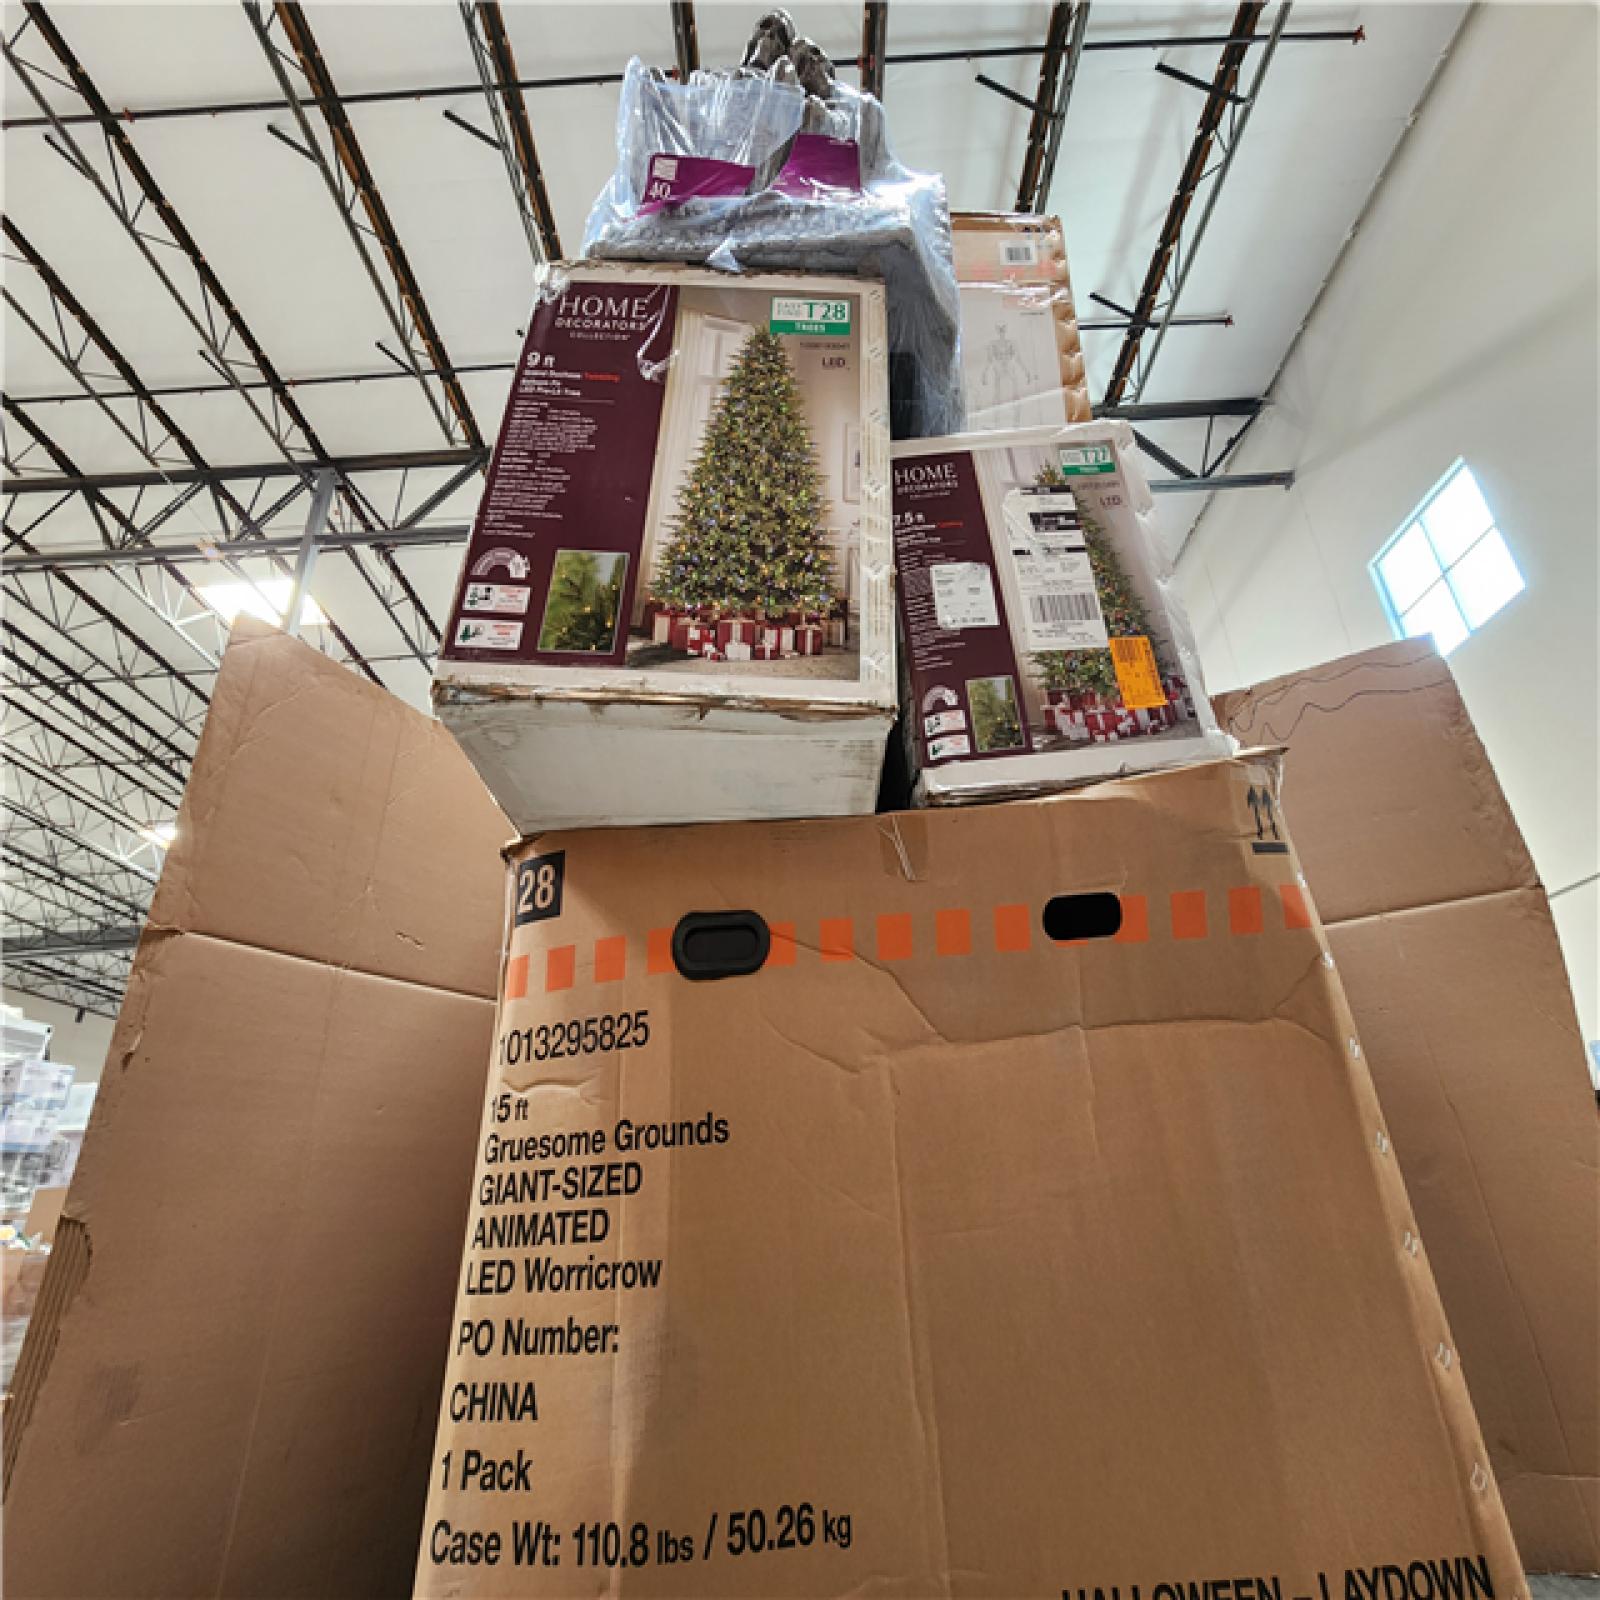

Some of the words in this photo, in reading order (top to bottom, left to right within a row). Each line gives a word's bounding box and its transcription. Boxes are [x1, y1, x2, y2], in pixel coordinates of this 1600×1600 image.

[559, 294, 648, 319] HOME
[894, 463, 959, 485] HOME
[518, 864, 556, 914] 28
[515, 1098, 529, 1120] ft
[485, 1129, 605, 1164] Gruesome
[614, 1112, 729, 1151] Grounds
[479, 1162, 642, 1206] GIANT-SIZED
[472, 1208, 610, 1249] ANIMATED
[465, 1259, 515, 1295] LED
[524, 1254, 662, 1293] Worricrow
[457, 1319, 495, 1356] PO
[502, 1315, 619, 1356] Number:
[450, 1381, 538, 1422] CHINA
[442, 1451, 452, 1490] 1
[460, 1449, 533, 1491] Pack
[431, 1520, 500, 1566] Case
[512, 1521, 560, 1566] Wt:
[572, 1521, 649, 1567] 110.8
[656, 1530, 694, 1565] lbs
[702, 1512, 719, 1560] /
[726, 1502, 816, 1556] 50.26
[822, 1509, 852, 1549] kg
